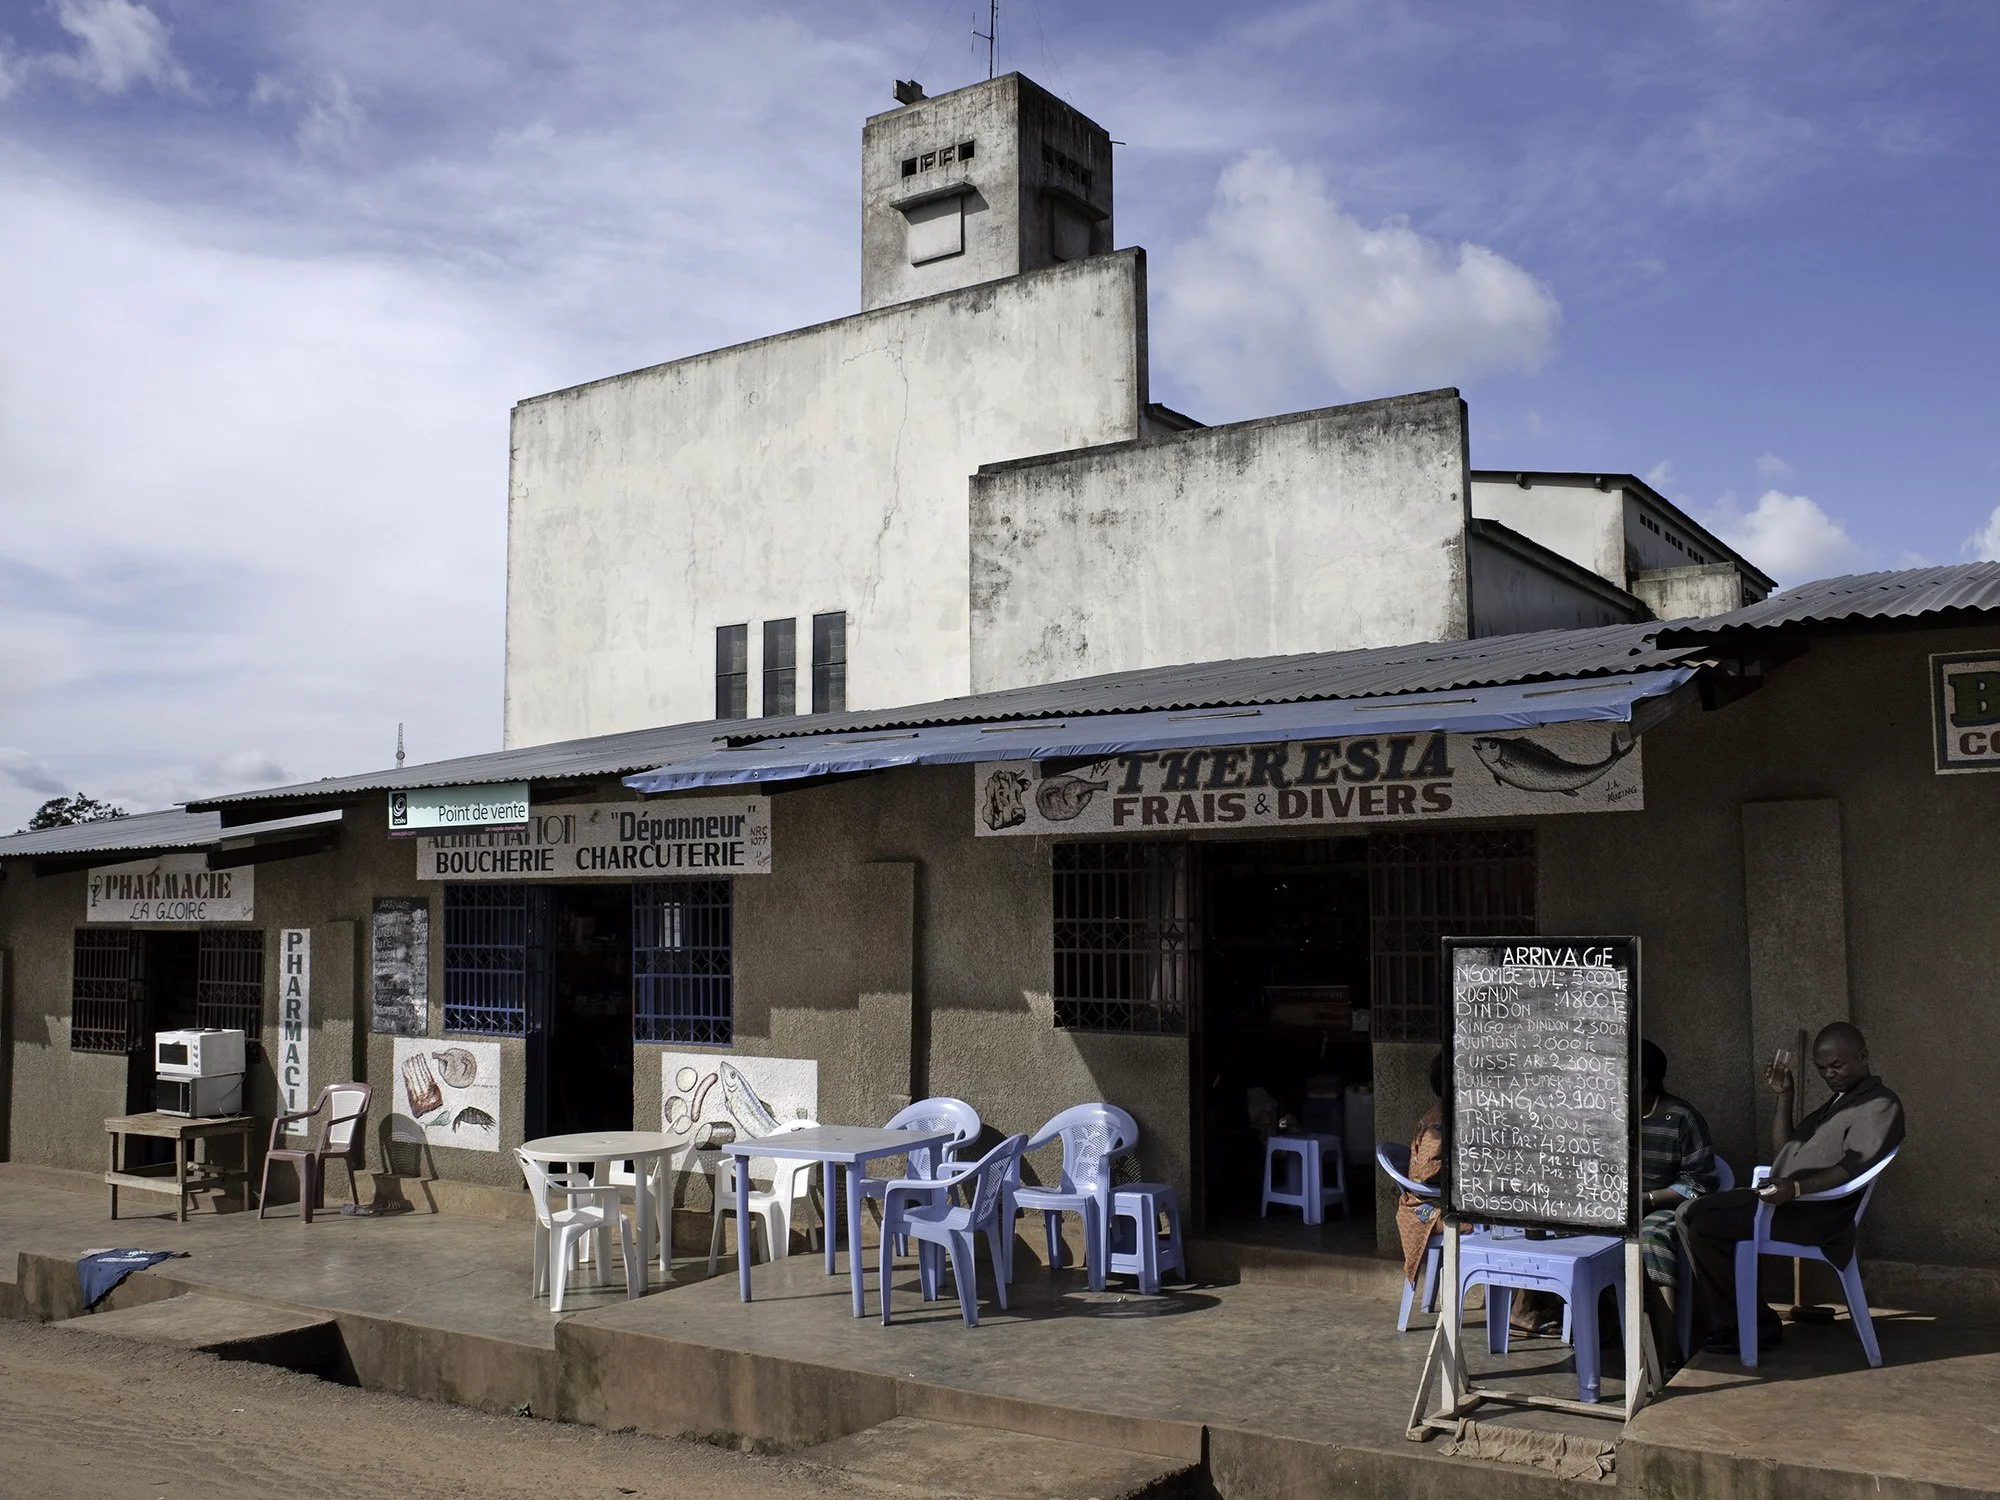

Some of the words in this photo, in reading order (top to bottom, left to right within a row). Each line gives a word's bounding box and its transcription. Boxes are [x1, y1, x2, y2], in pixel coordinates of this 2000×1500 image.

[1116, 733, 1456, 794] THERESIA
[438, 805, 470, 822] Point
[472, 803, 488, 820] de
[490, 803, 526, 819] vente
[1113, 792, 1247, 826] FRAIS
[1254, 793, 1271, 815] &
[1277, 783, 1453, 819] DIVERS
[436, 848, 554, 874] BOUCHERIE
[575, 841, 745, 870] CHARCUTERIE
[105, 872, 232, 900] PHARMACIE
[130, 902, 150, 920] LA
[156, 901, 207, 920] GLOIRE
[1502, 946, 1614, 968] ARRIVAGE
[1456, 1002, 1531, 1019] DINDON
[283, 932, 303, 1132] PHARMACIE
[1453, 1033, 1518, 1050] POUMON
[1453, 1053, 1518, 1071] CUISSE
[1508, 1075, 1522, 1090] A
